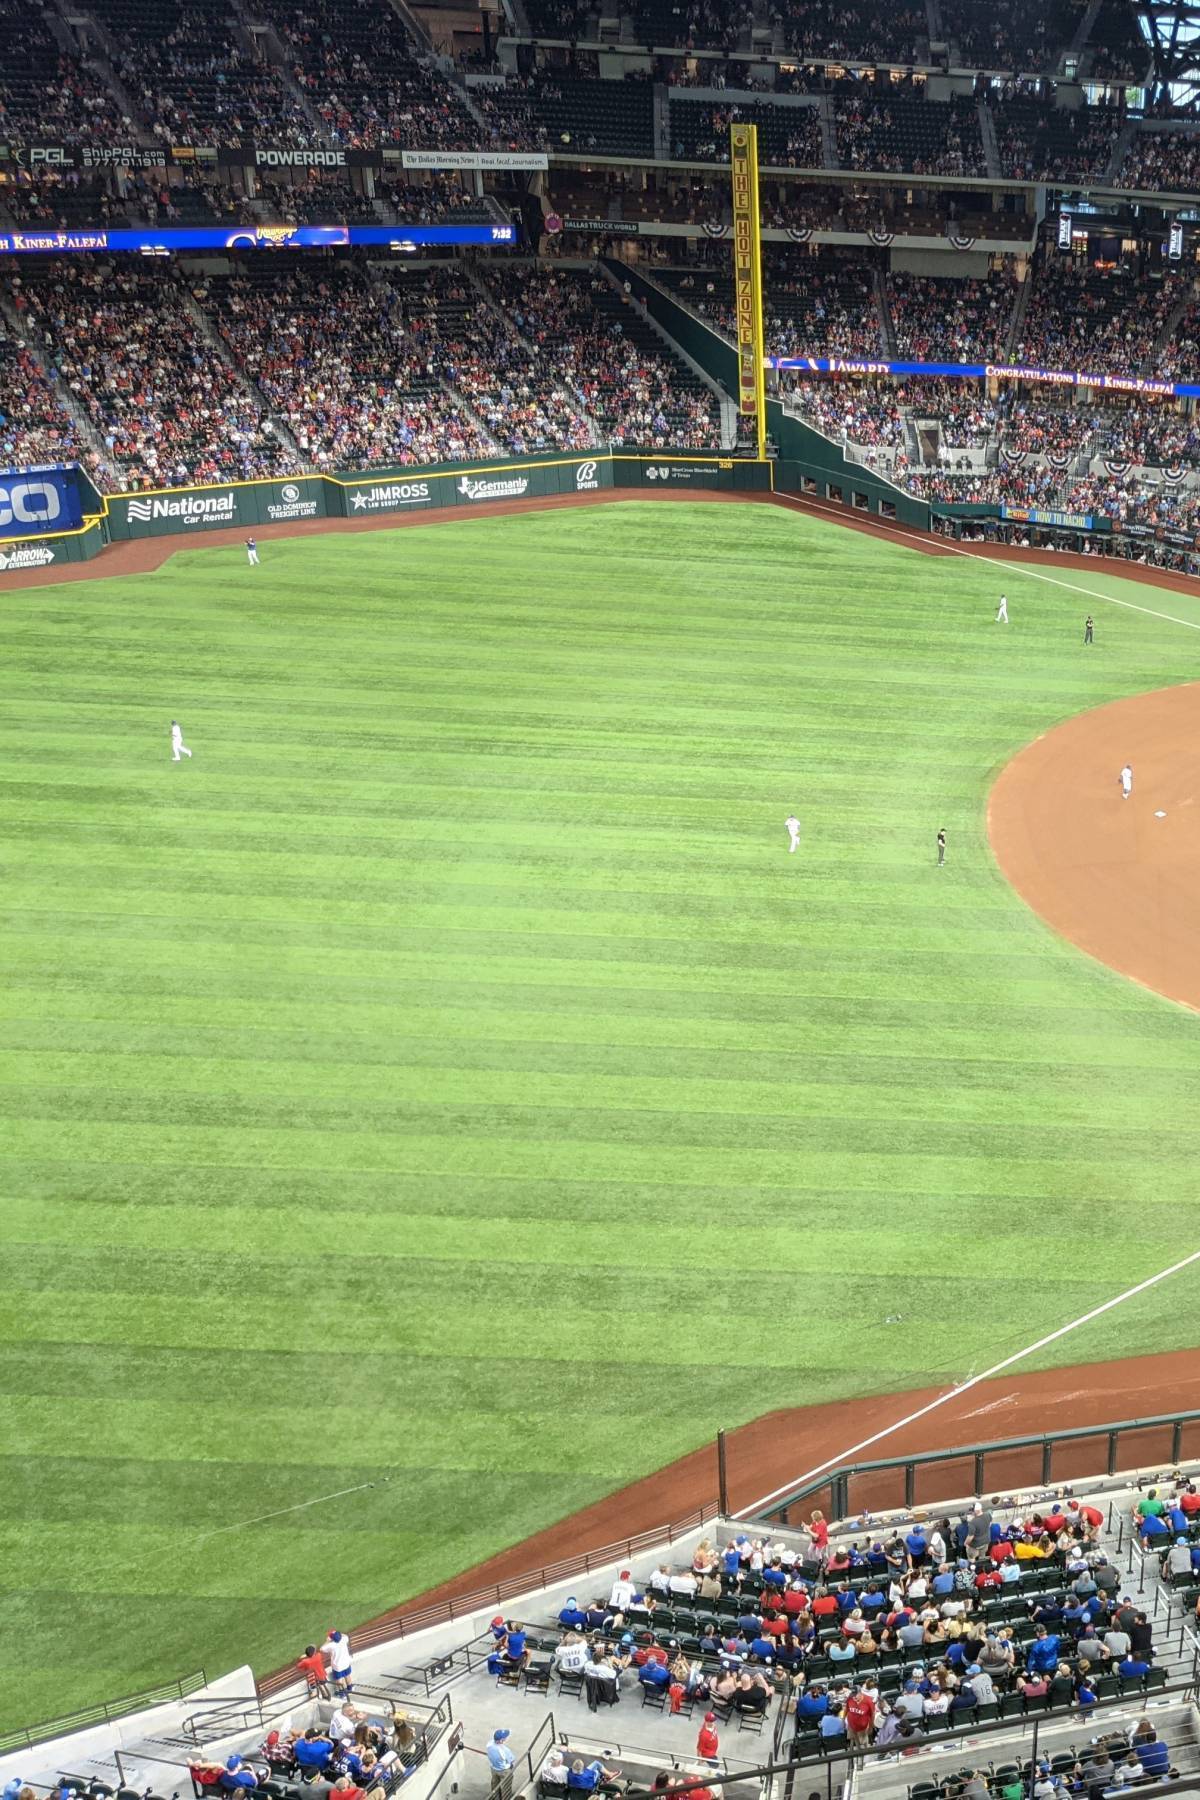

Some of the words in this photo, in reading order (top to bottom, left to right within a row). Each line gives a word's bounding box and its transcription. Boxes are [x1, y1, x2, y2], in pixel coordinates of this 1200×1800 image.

[31, 148, 74, 163] PGL
[82, 147, 165, 158] ShipPGL.com
[256, 150, 347, 165] POWERADE
[84, 158, 166, 167] 877.701.1919
[436, 156, 460, 165] Morning
[736, 160, 748, 204] THE
[588, 222, 613, 230] TRUCK
[614, 223, 637, 231] WORLD
[492, 228, 512, 239] 7:32
[738, 222, 749, 268] HOT
[740, 281, 752, 343] ZONE
[985, 365, 1074, 383] CONGRATULATIONS
[31, 464, 57, 472] GEICO
[719, 461, 733, 469] 326
[478, 476, 527, 491] Germania
[577, 480, 599, 490] SPORTS
[283, 501, 317, 510] DOMINION
[183, 515, 201, 524] Car
[202, 511, 233, 522] Rental
[271, 508, 300, 518] FREIGHT
[301, 507, 316, 516] LINE
[1036, 511, 1051, 522] HOW
[1053, 513, 1063, 523] TO
[10, 548, 45, 561] ARROW
[565, 1656, 580, 1668] 10
[980, 1684, 991, 1697] 16
